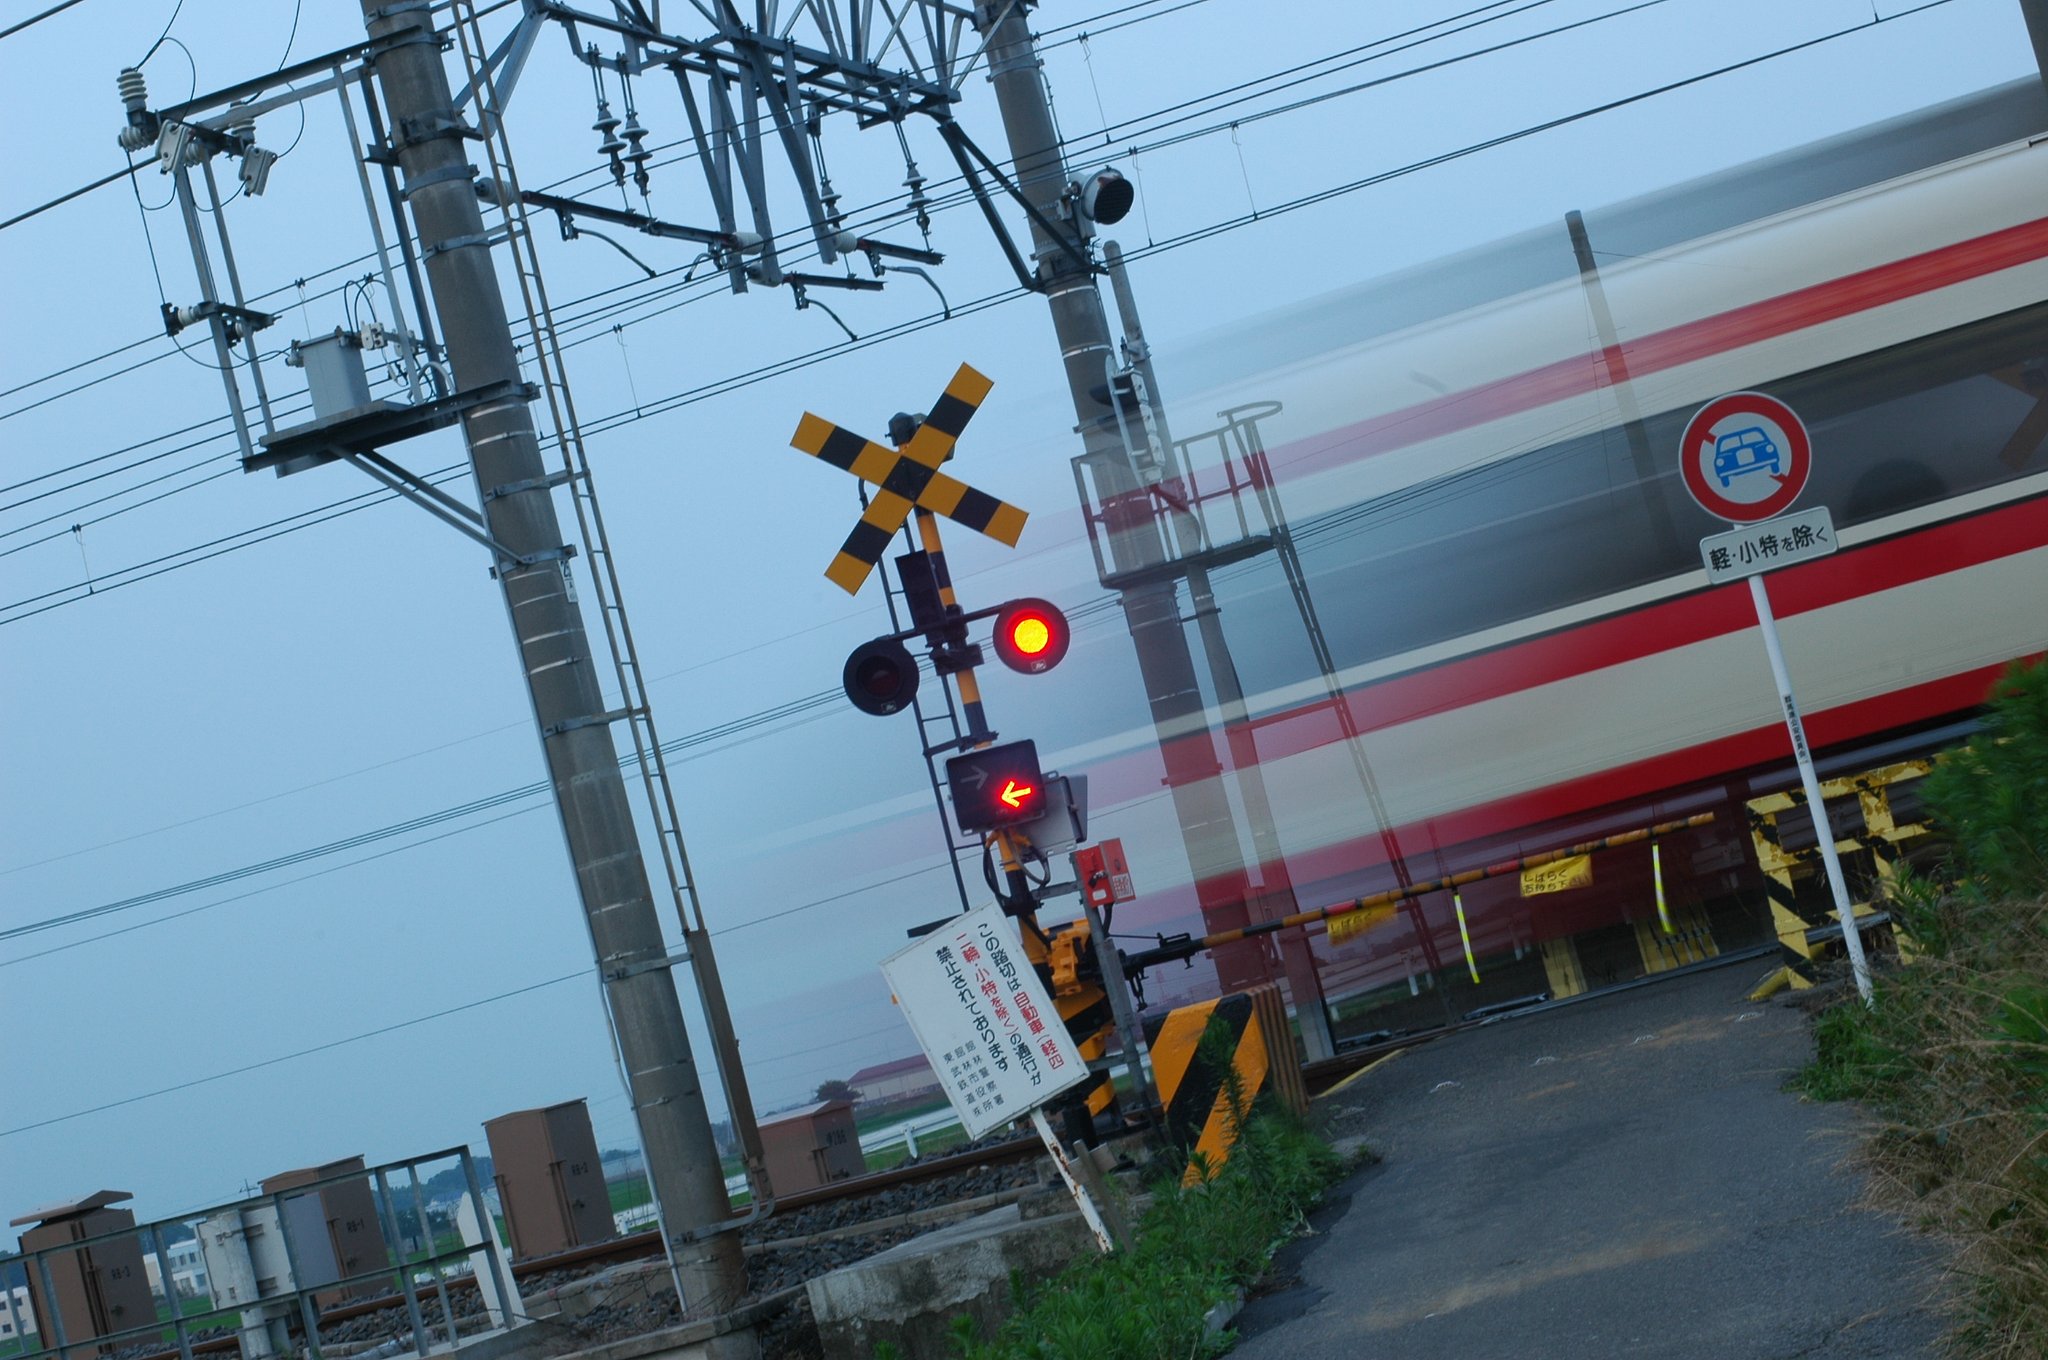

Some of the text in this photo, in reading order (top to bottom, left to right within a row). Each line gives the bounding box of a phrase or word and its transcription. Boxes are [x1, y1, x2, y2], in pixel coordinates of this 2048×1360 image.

[1709, 525, 1828, 572] 軽・小特を除く
[935, 945, 1010, 1073] 禁止されております
